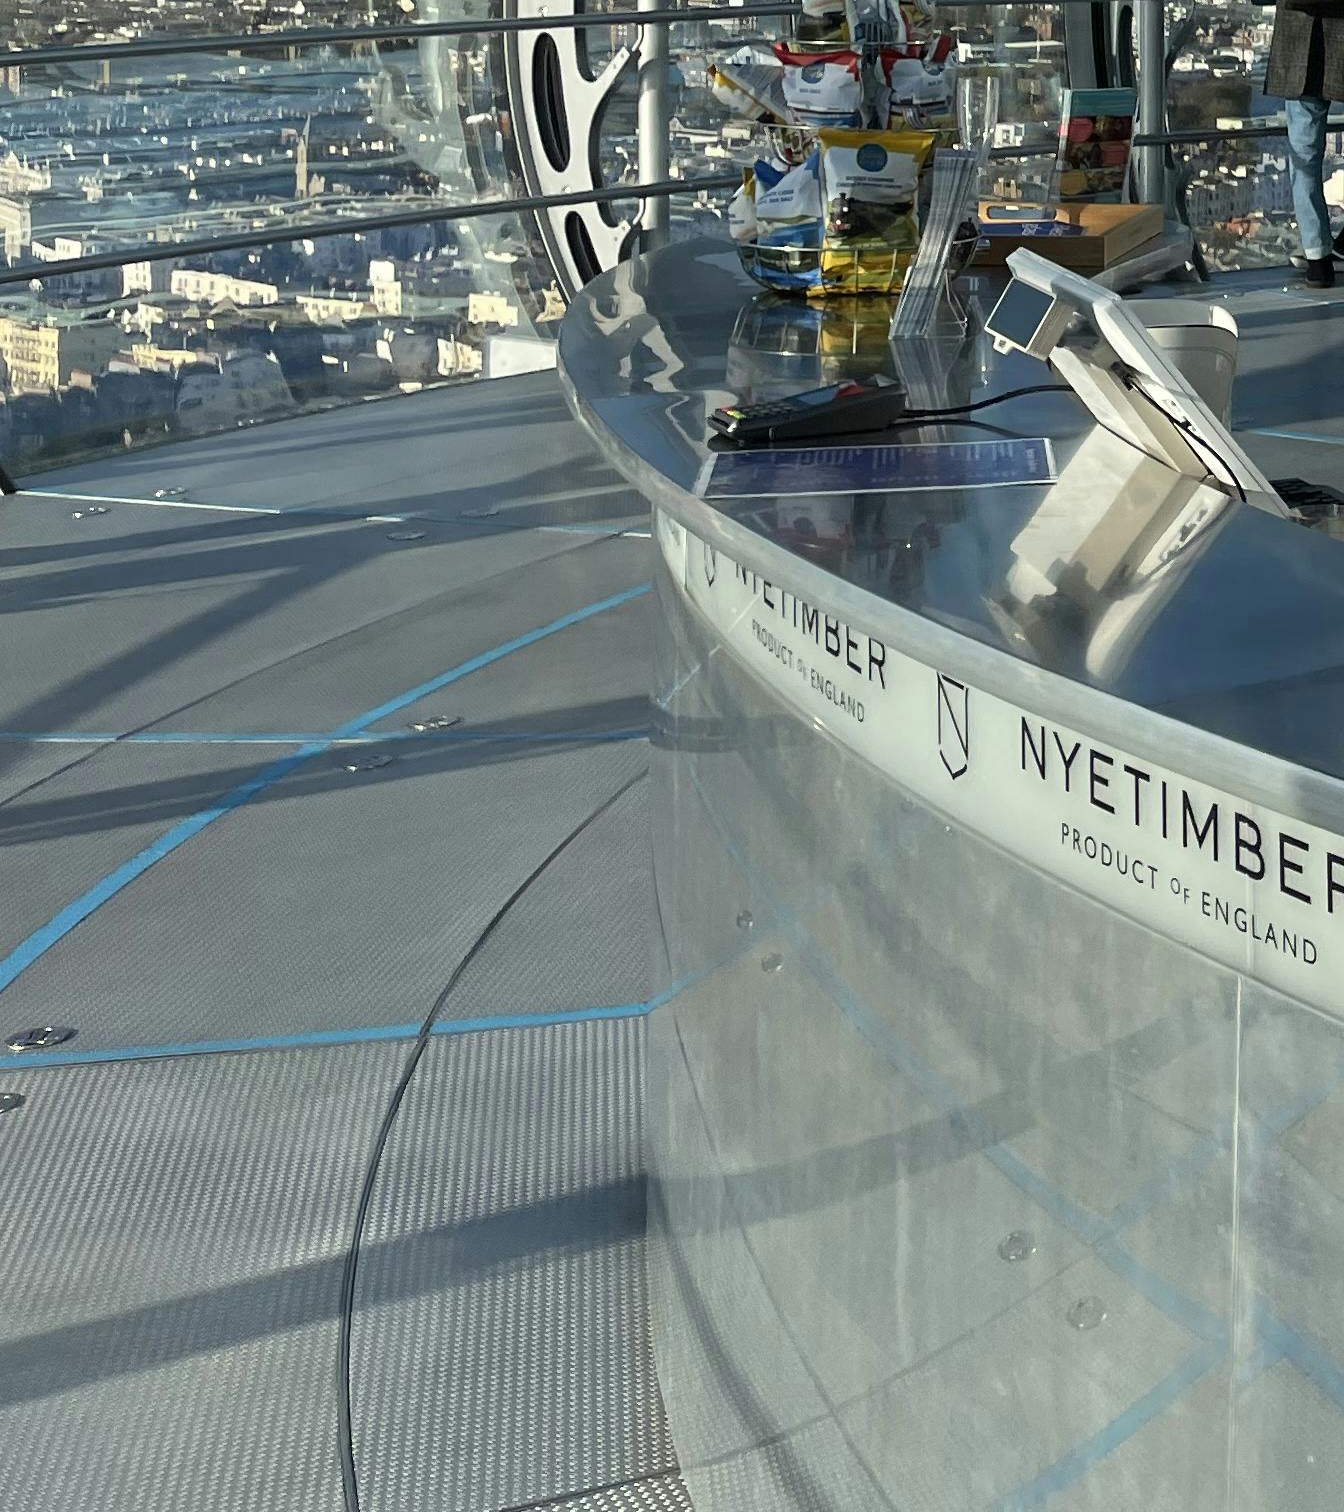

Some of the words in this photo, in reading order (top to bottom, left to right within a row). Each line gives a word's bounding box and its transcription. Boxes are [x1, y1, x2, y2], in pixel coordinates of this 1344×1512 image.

[752, 618, 793, 669] PRODUCT
[810, 668, 865, 723] ENGLAND
[1060, 821, 1159, 892] PRODUCT
[1200, 891, 1318, 966] ENGLAND
